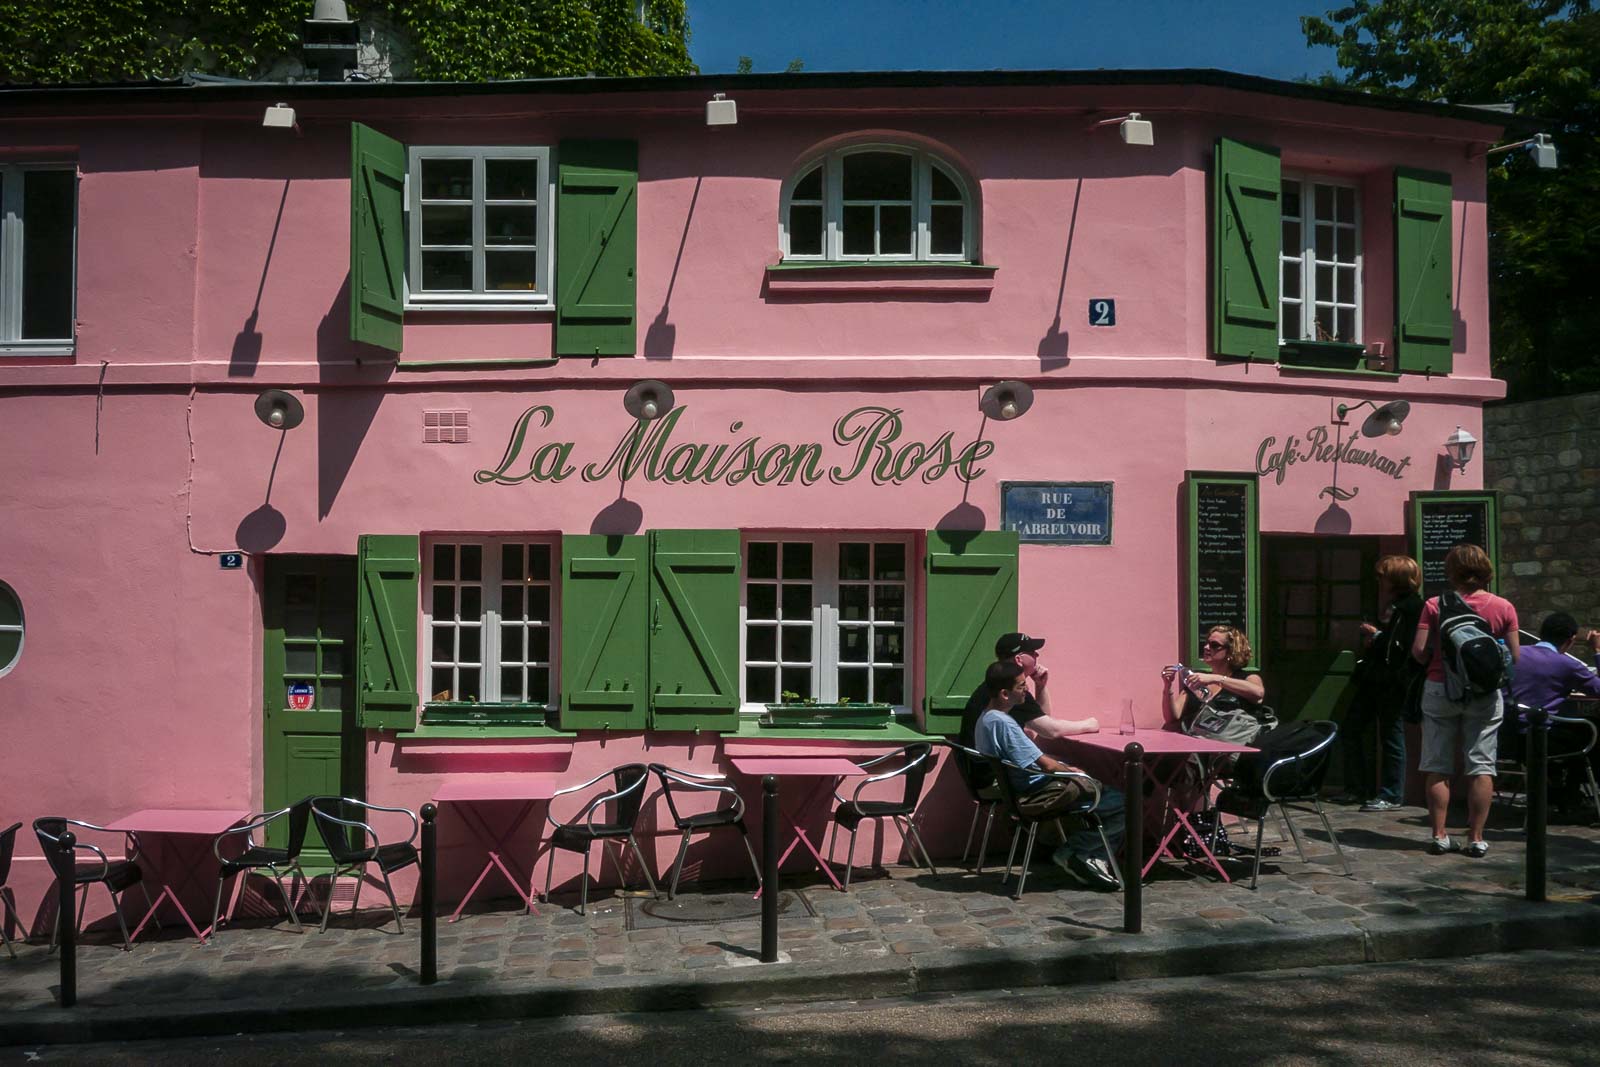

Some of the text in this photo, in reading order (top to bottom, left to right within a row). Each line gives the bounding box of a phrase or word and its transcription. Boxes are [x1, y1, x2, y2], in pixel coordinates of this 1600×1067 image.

[1095, 301, 1109, 324] 2
[474, 405, 995, 486] La Maison Rose
[1041, 492, 1073, 505] RUE
[1046, 508, 1066, 519] DE
[226, 555, 236, 566] 2
